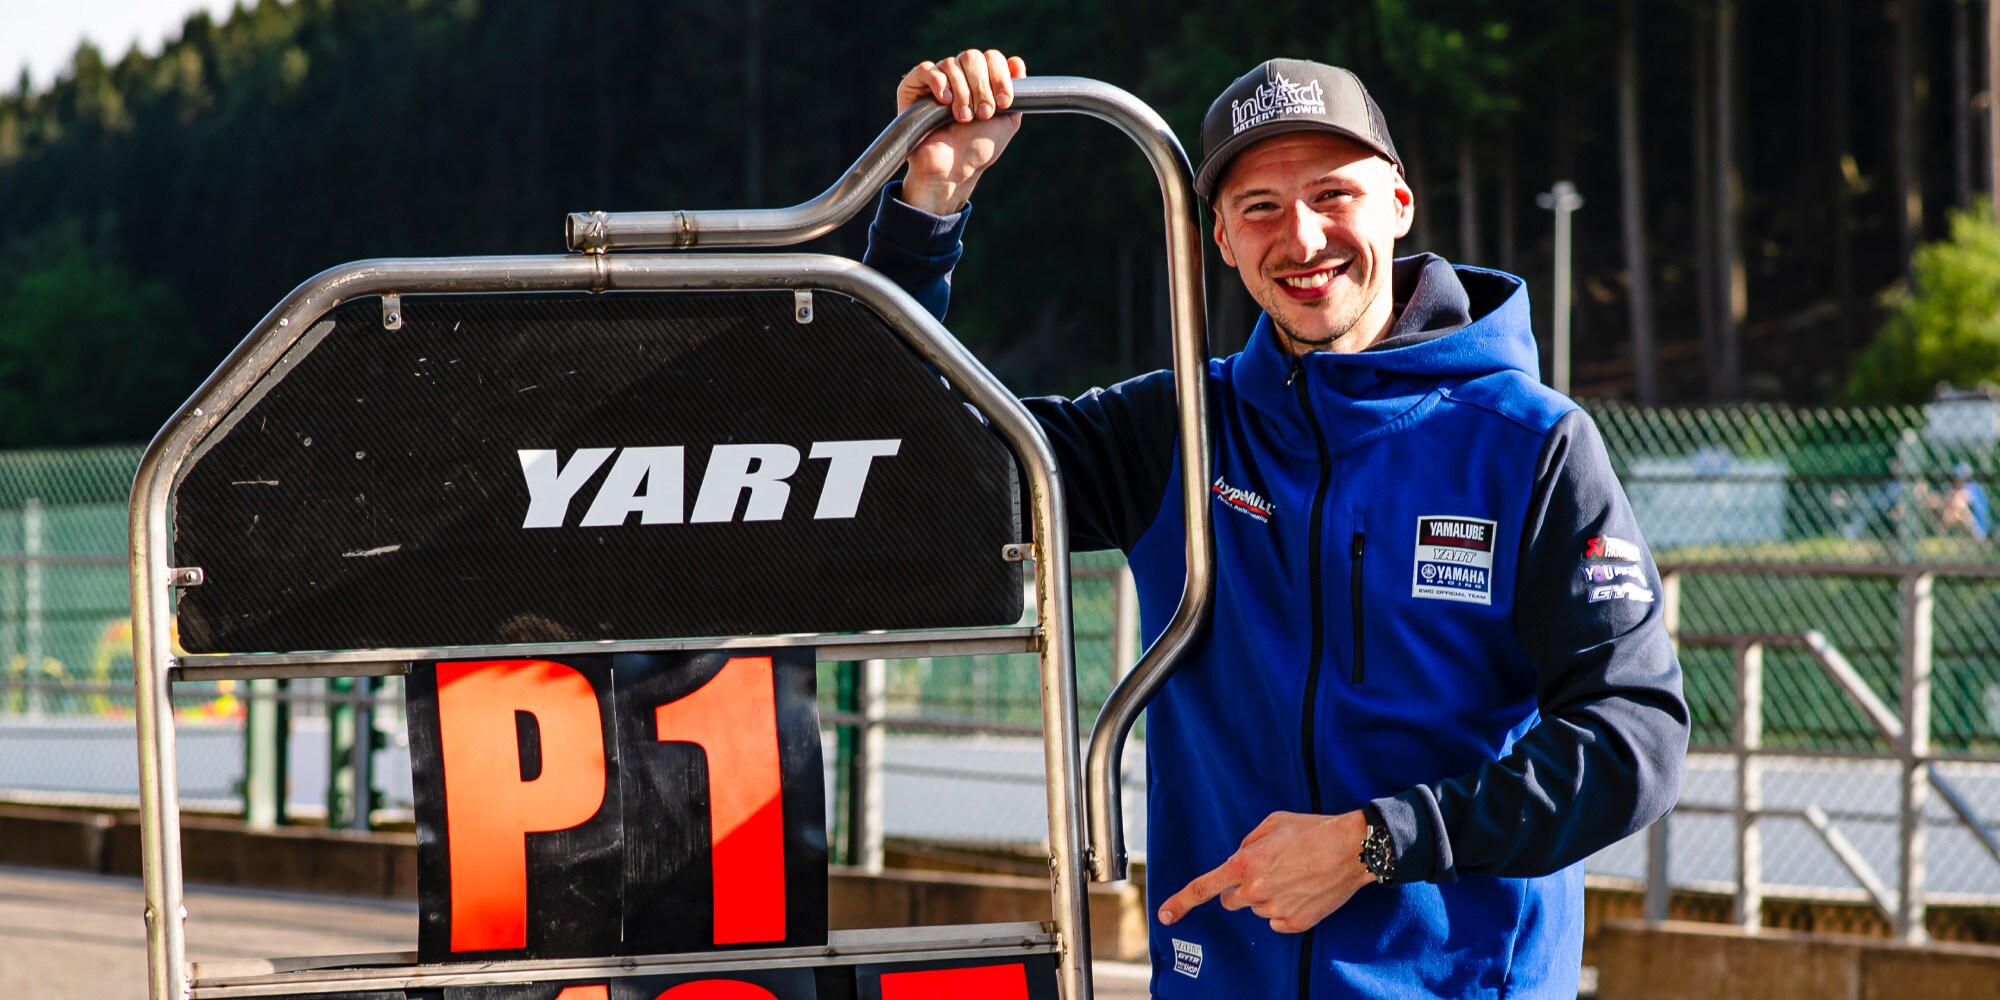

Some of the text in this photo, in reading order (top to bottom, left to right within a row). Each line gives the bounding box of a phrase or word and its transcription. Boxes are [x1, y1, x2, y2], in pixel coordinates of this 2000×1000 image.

[517, 439, 902, 528] YART
[1430, 521, 1485, 541] YAMALUBE
[1433, 548, 1477, 563] YART
[1437, 565, 1485, 585] YAMAHA
[1426, 579, 1482, 589] RACING
[1436, 589, 1466, 597] OFFICIAL
